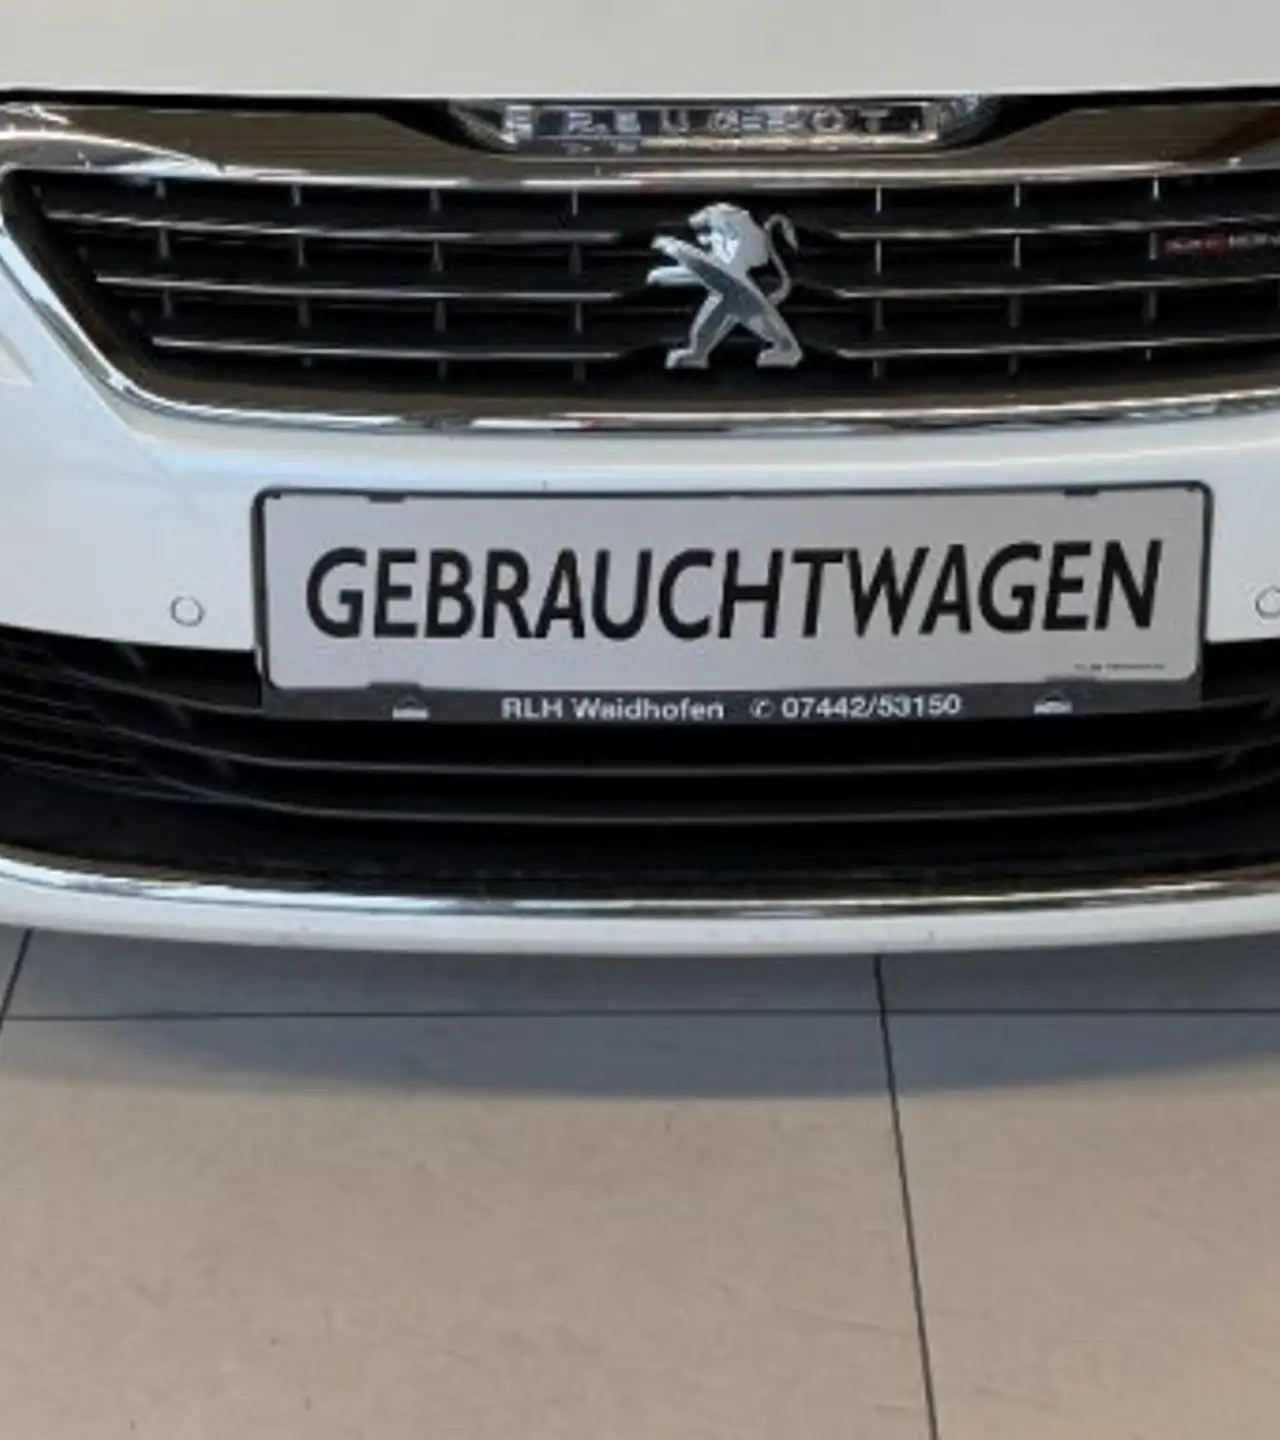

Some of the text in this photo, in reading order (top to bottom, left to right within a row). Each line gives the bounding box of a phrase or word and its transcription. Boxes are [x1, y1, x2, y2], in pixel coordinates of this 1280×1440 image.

[306, 539, 1163, 640] GEBRAUCHTWAGEN
[500, 693, 963, 721] RLH Waidhofen 07442/53150
